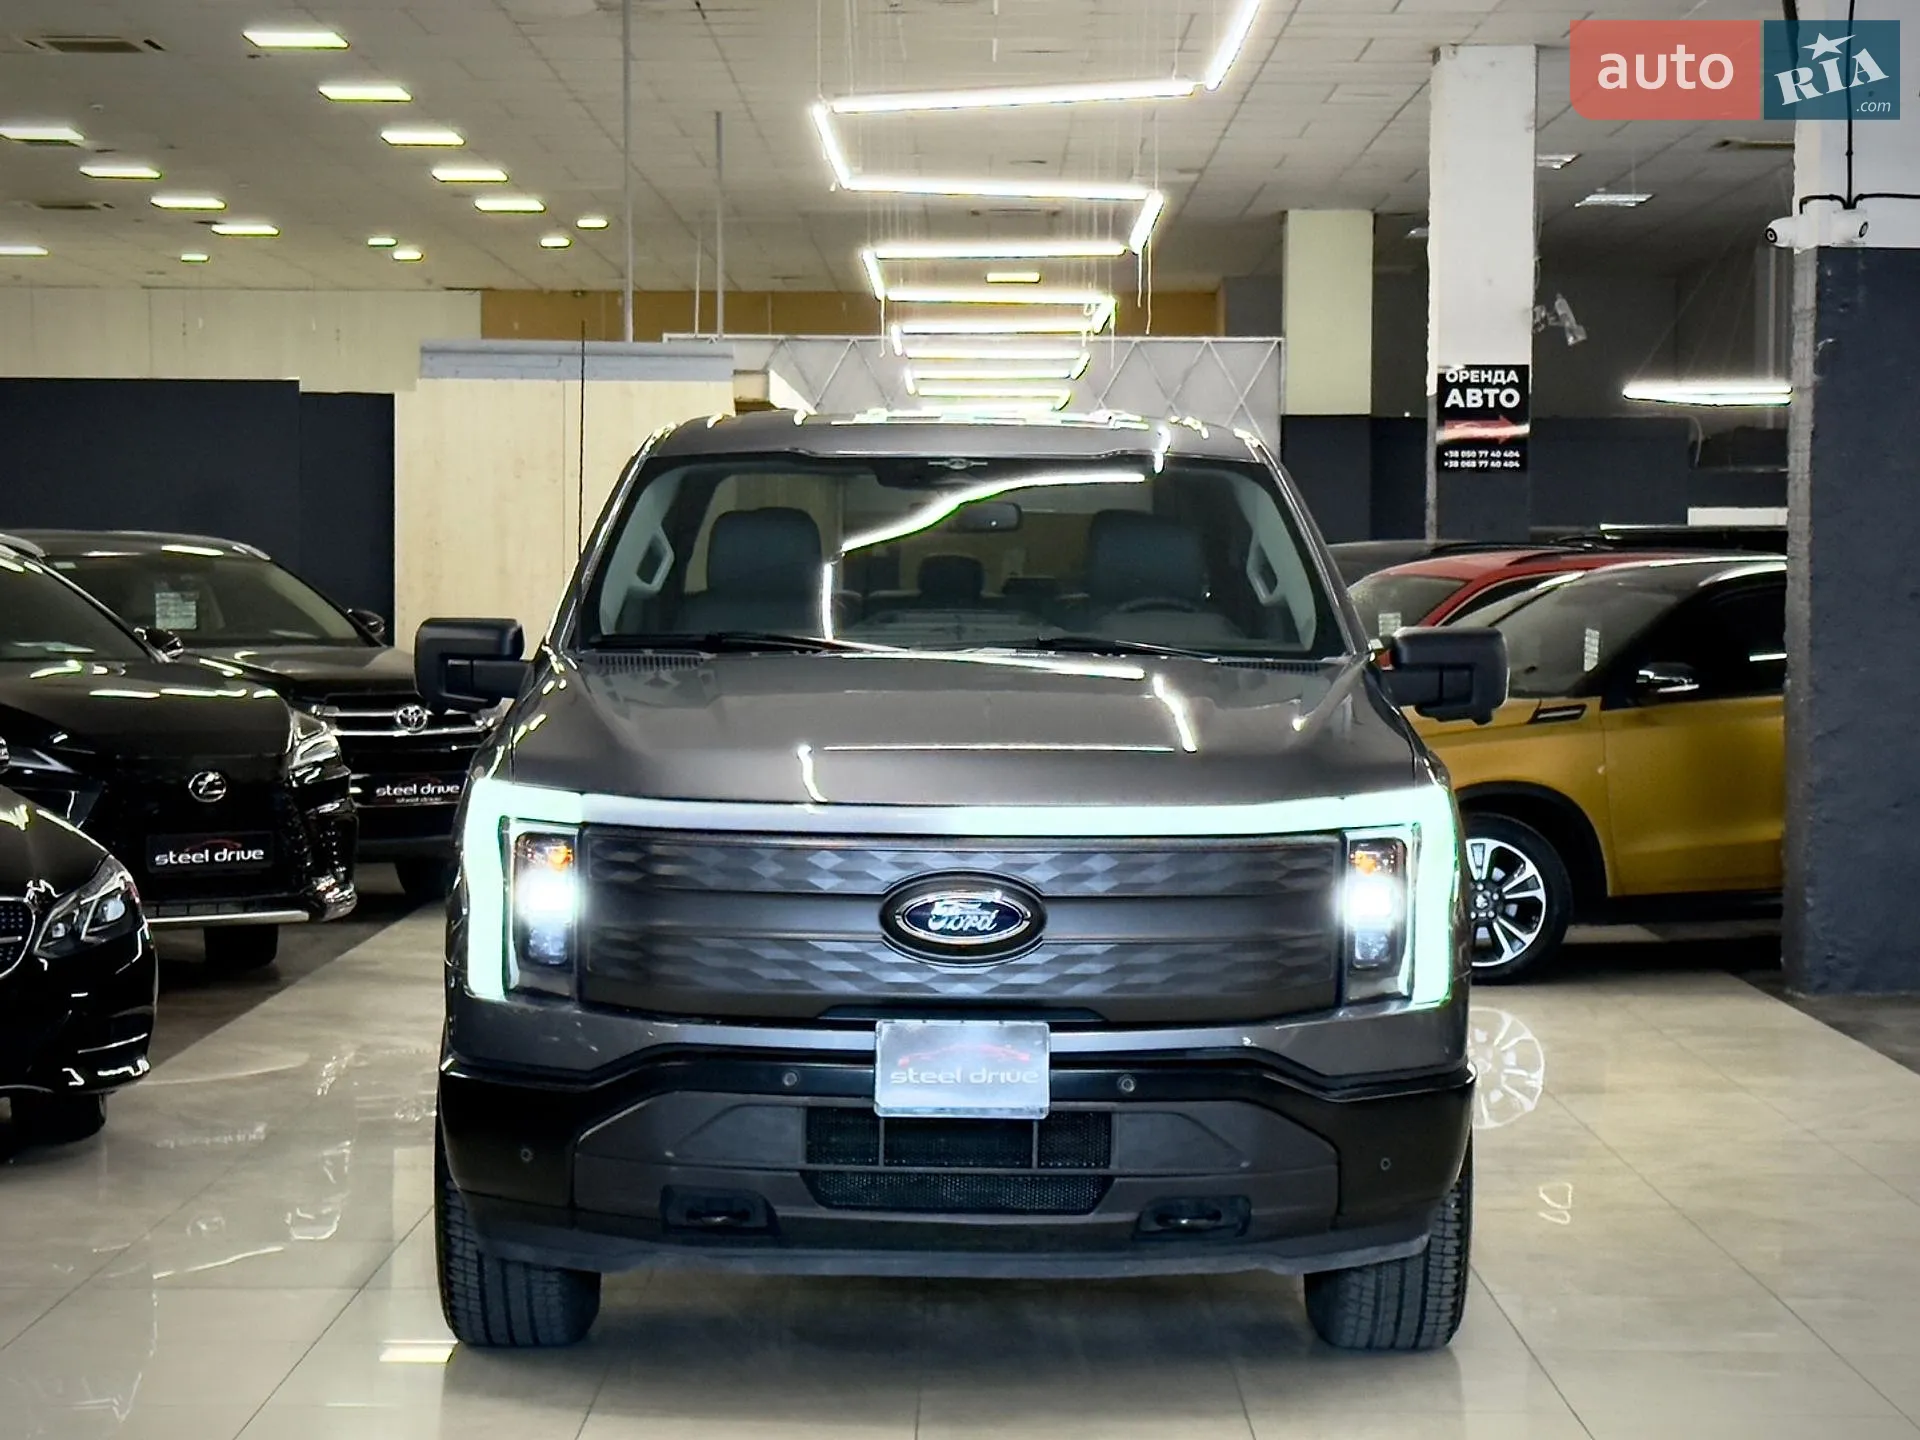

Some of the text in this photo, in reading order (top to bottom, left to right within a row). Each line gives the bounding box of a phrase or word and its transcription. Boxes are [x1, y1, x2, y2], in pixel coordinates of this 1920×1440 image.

[1445, 369, 1519, 385] ОРЕНДА
[1444, 388, 1520, 409] АВТО
[376, 783, 460, 797] steel drive
[155, 848, 264, 866] steel drive
[927, 901, 1000, 932] Ford
[890, 1067, 1039, 1084] steel drive
